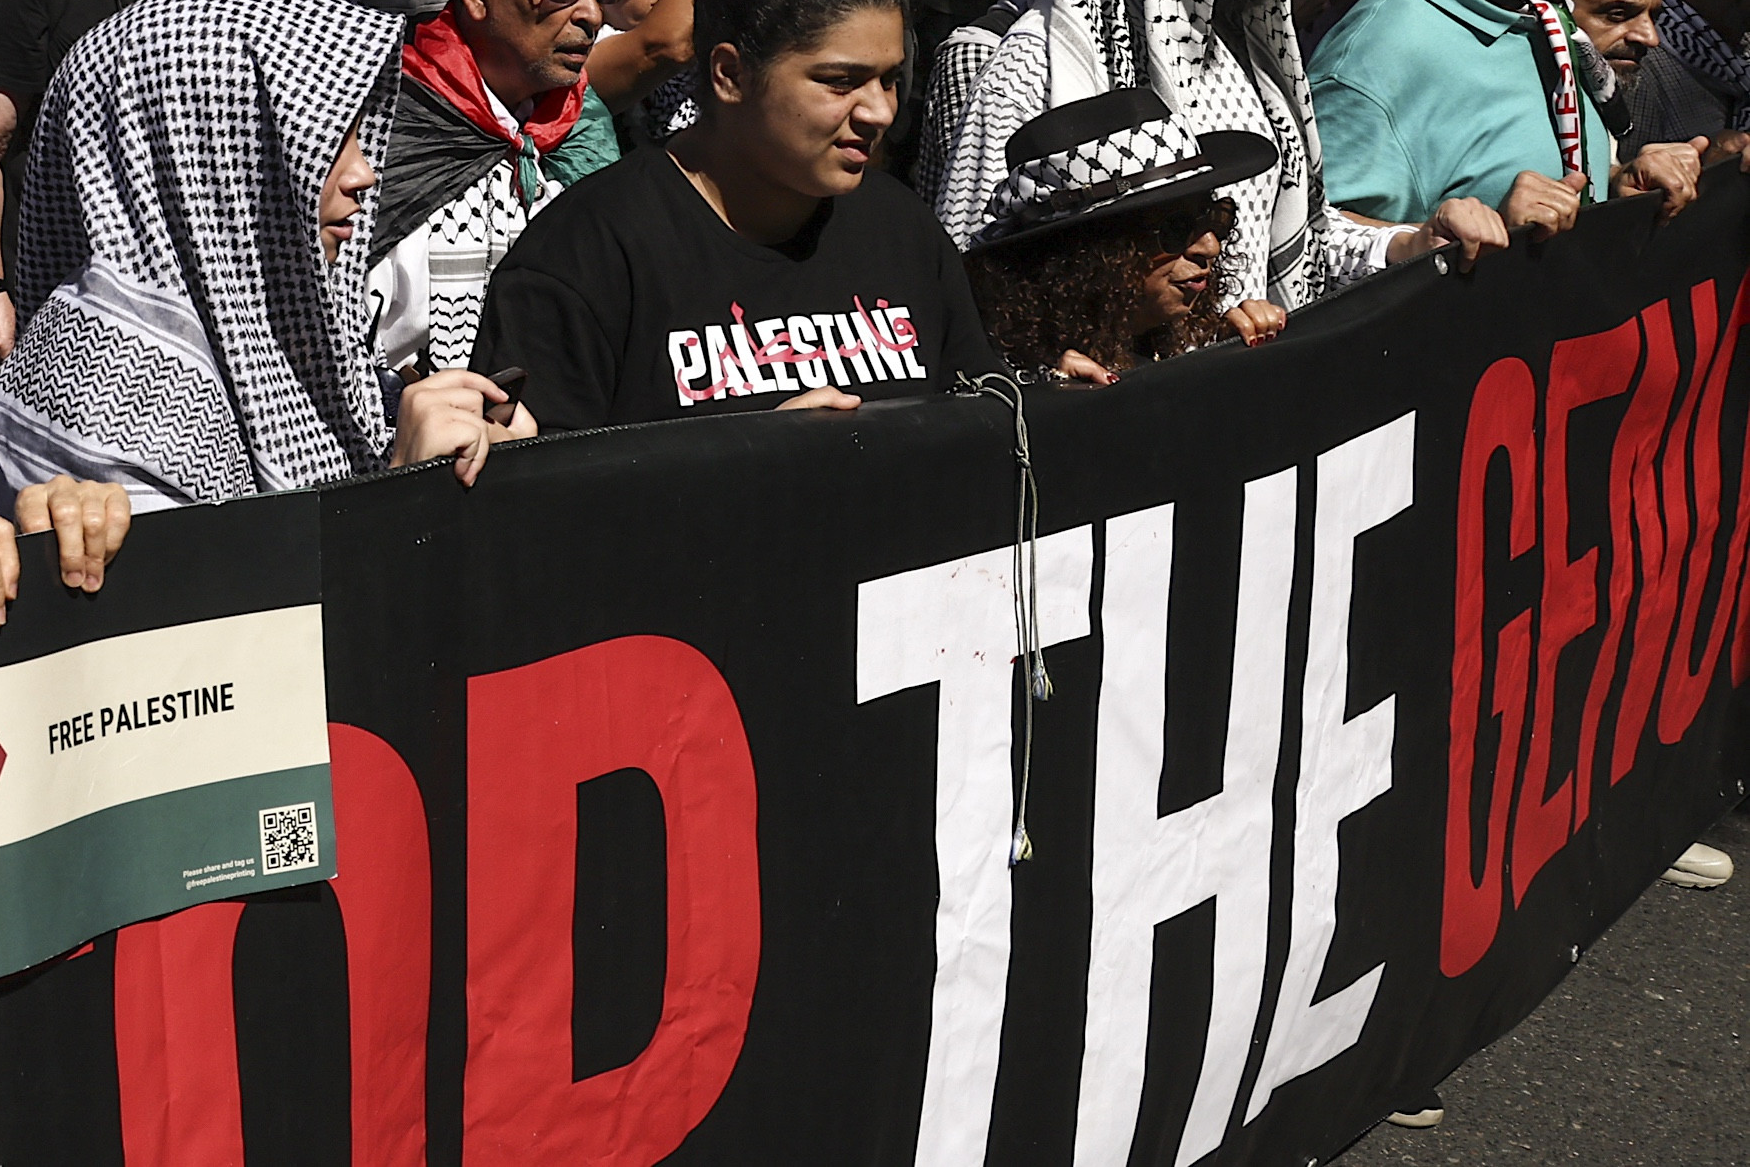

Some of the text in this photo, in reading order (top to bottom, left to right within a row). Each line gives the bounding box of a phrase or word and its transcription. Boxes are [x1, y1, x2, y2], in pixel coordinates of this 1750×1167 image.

[668, 306, 927, 407] PALESTINE
[49, 682, 235, 755] FREE PALESTINE
[857, 410, 1416, 1167] THE
[183, 868, 203, 878] Please
[204, 863, 221, 873] share
[222, 860, 233, 868] and
[186, 868, 256, 890] @freepalestineprinting
